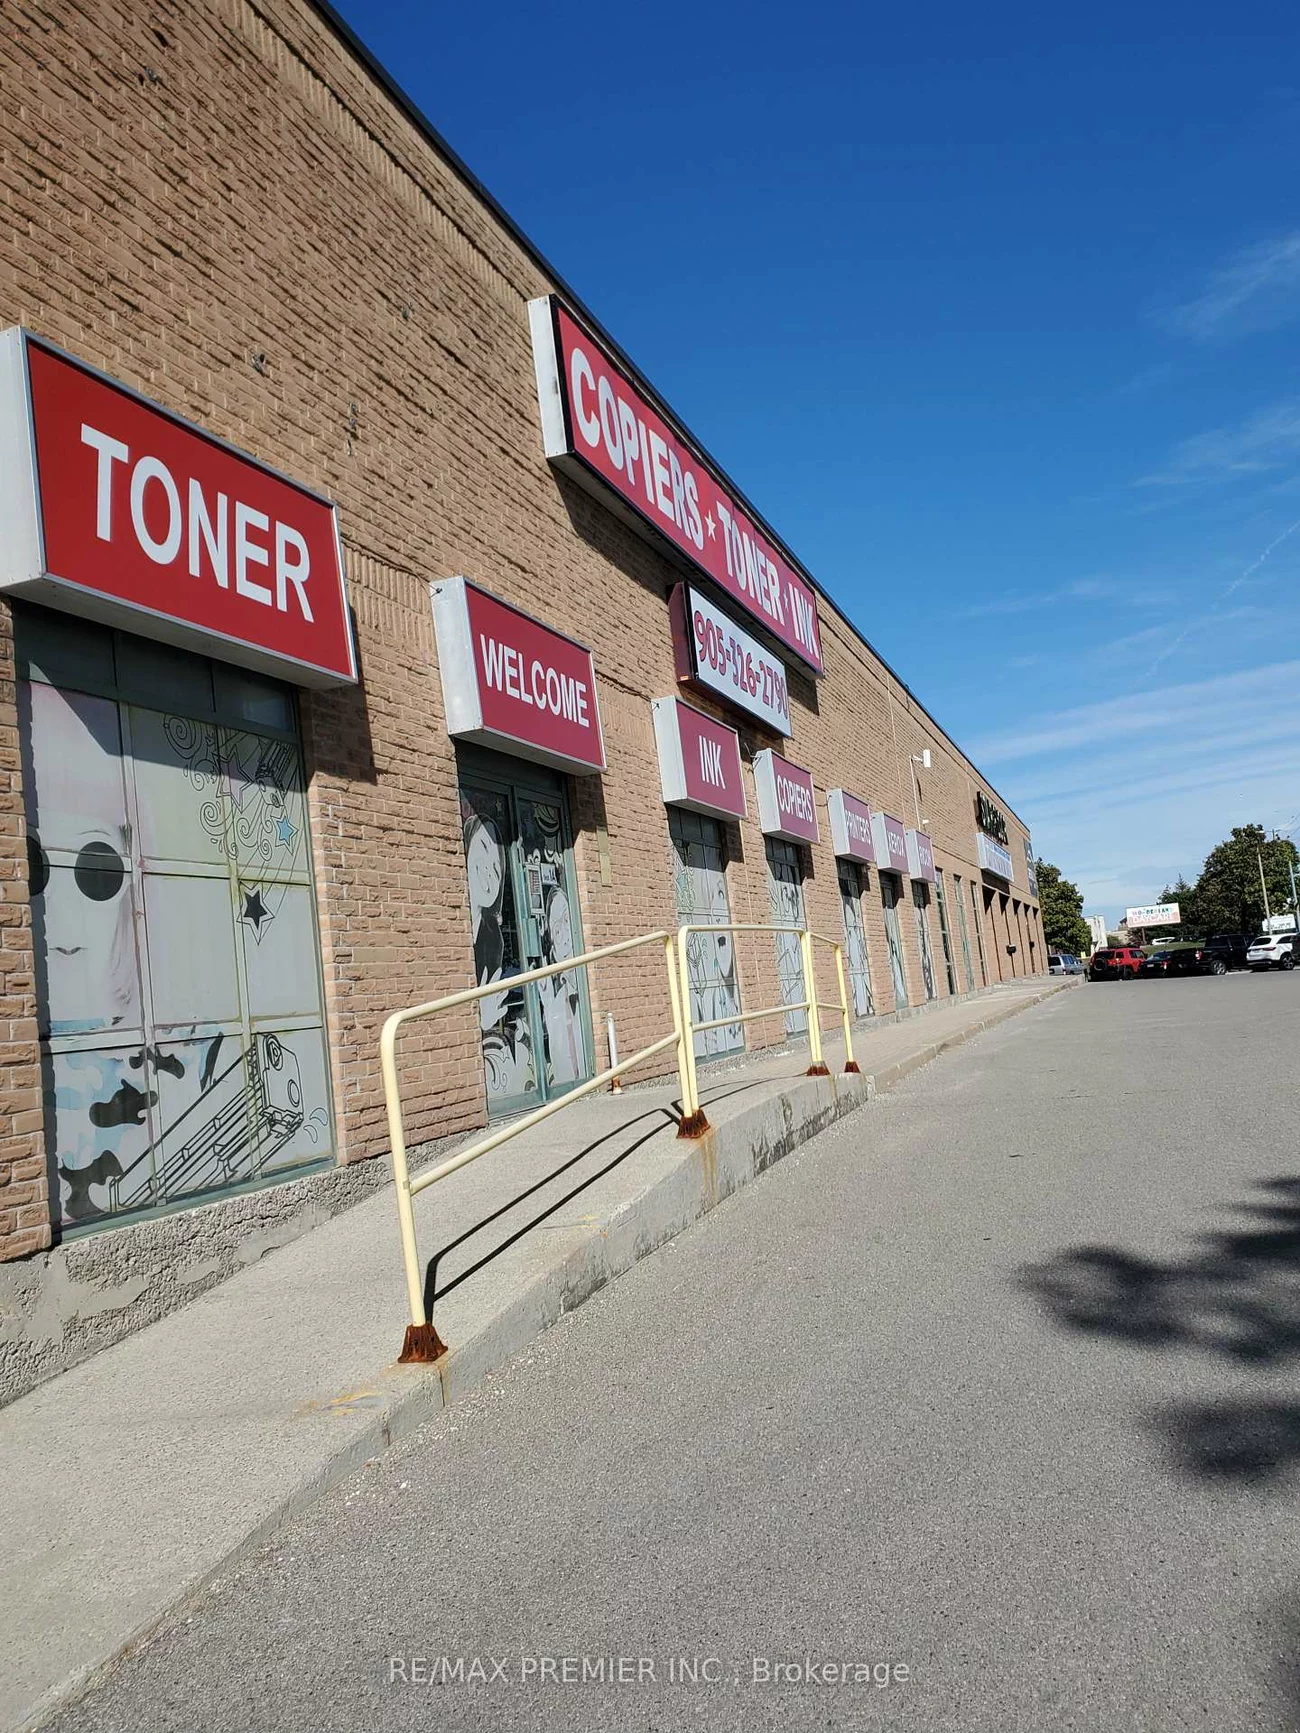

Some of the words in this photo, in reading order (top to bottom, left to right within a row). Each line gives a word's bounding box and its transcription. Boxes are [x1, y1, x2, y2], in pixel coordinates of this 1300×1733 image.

[80, 423, 314, 623] TONER
[570, 347, 704, 551] COPIERS
[717, 499, 785, 627] TONER
[787, 582, 819, 660] INK
[479, 633, 590, 727] WELCOME
[698, 735, 726, 789] INK
[777, 774, 813, 823] COPIERS
